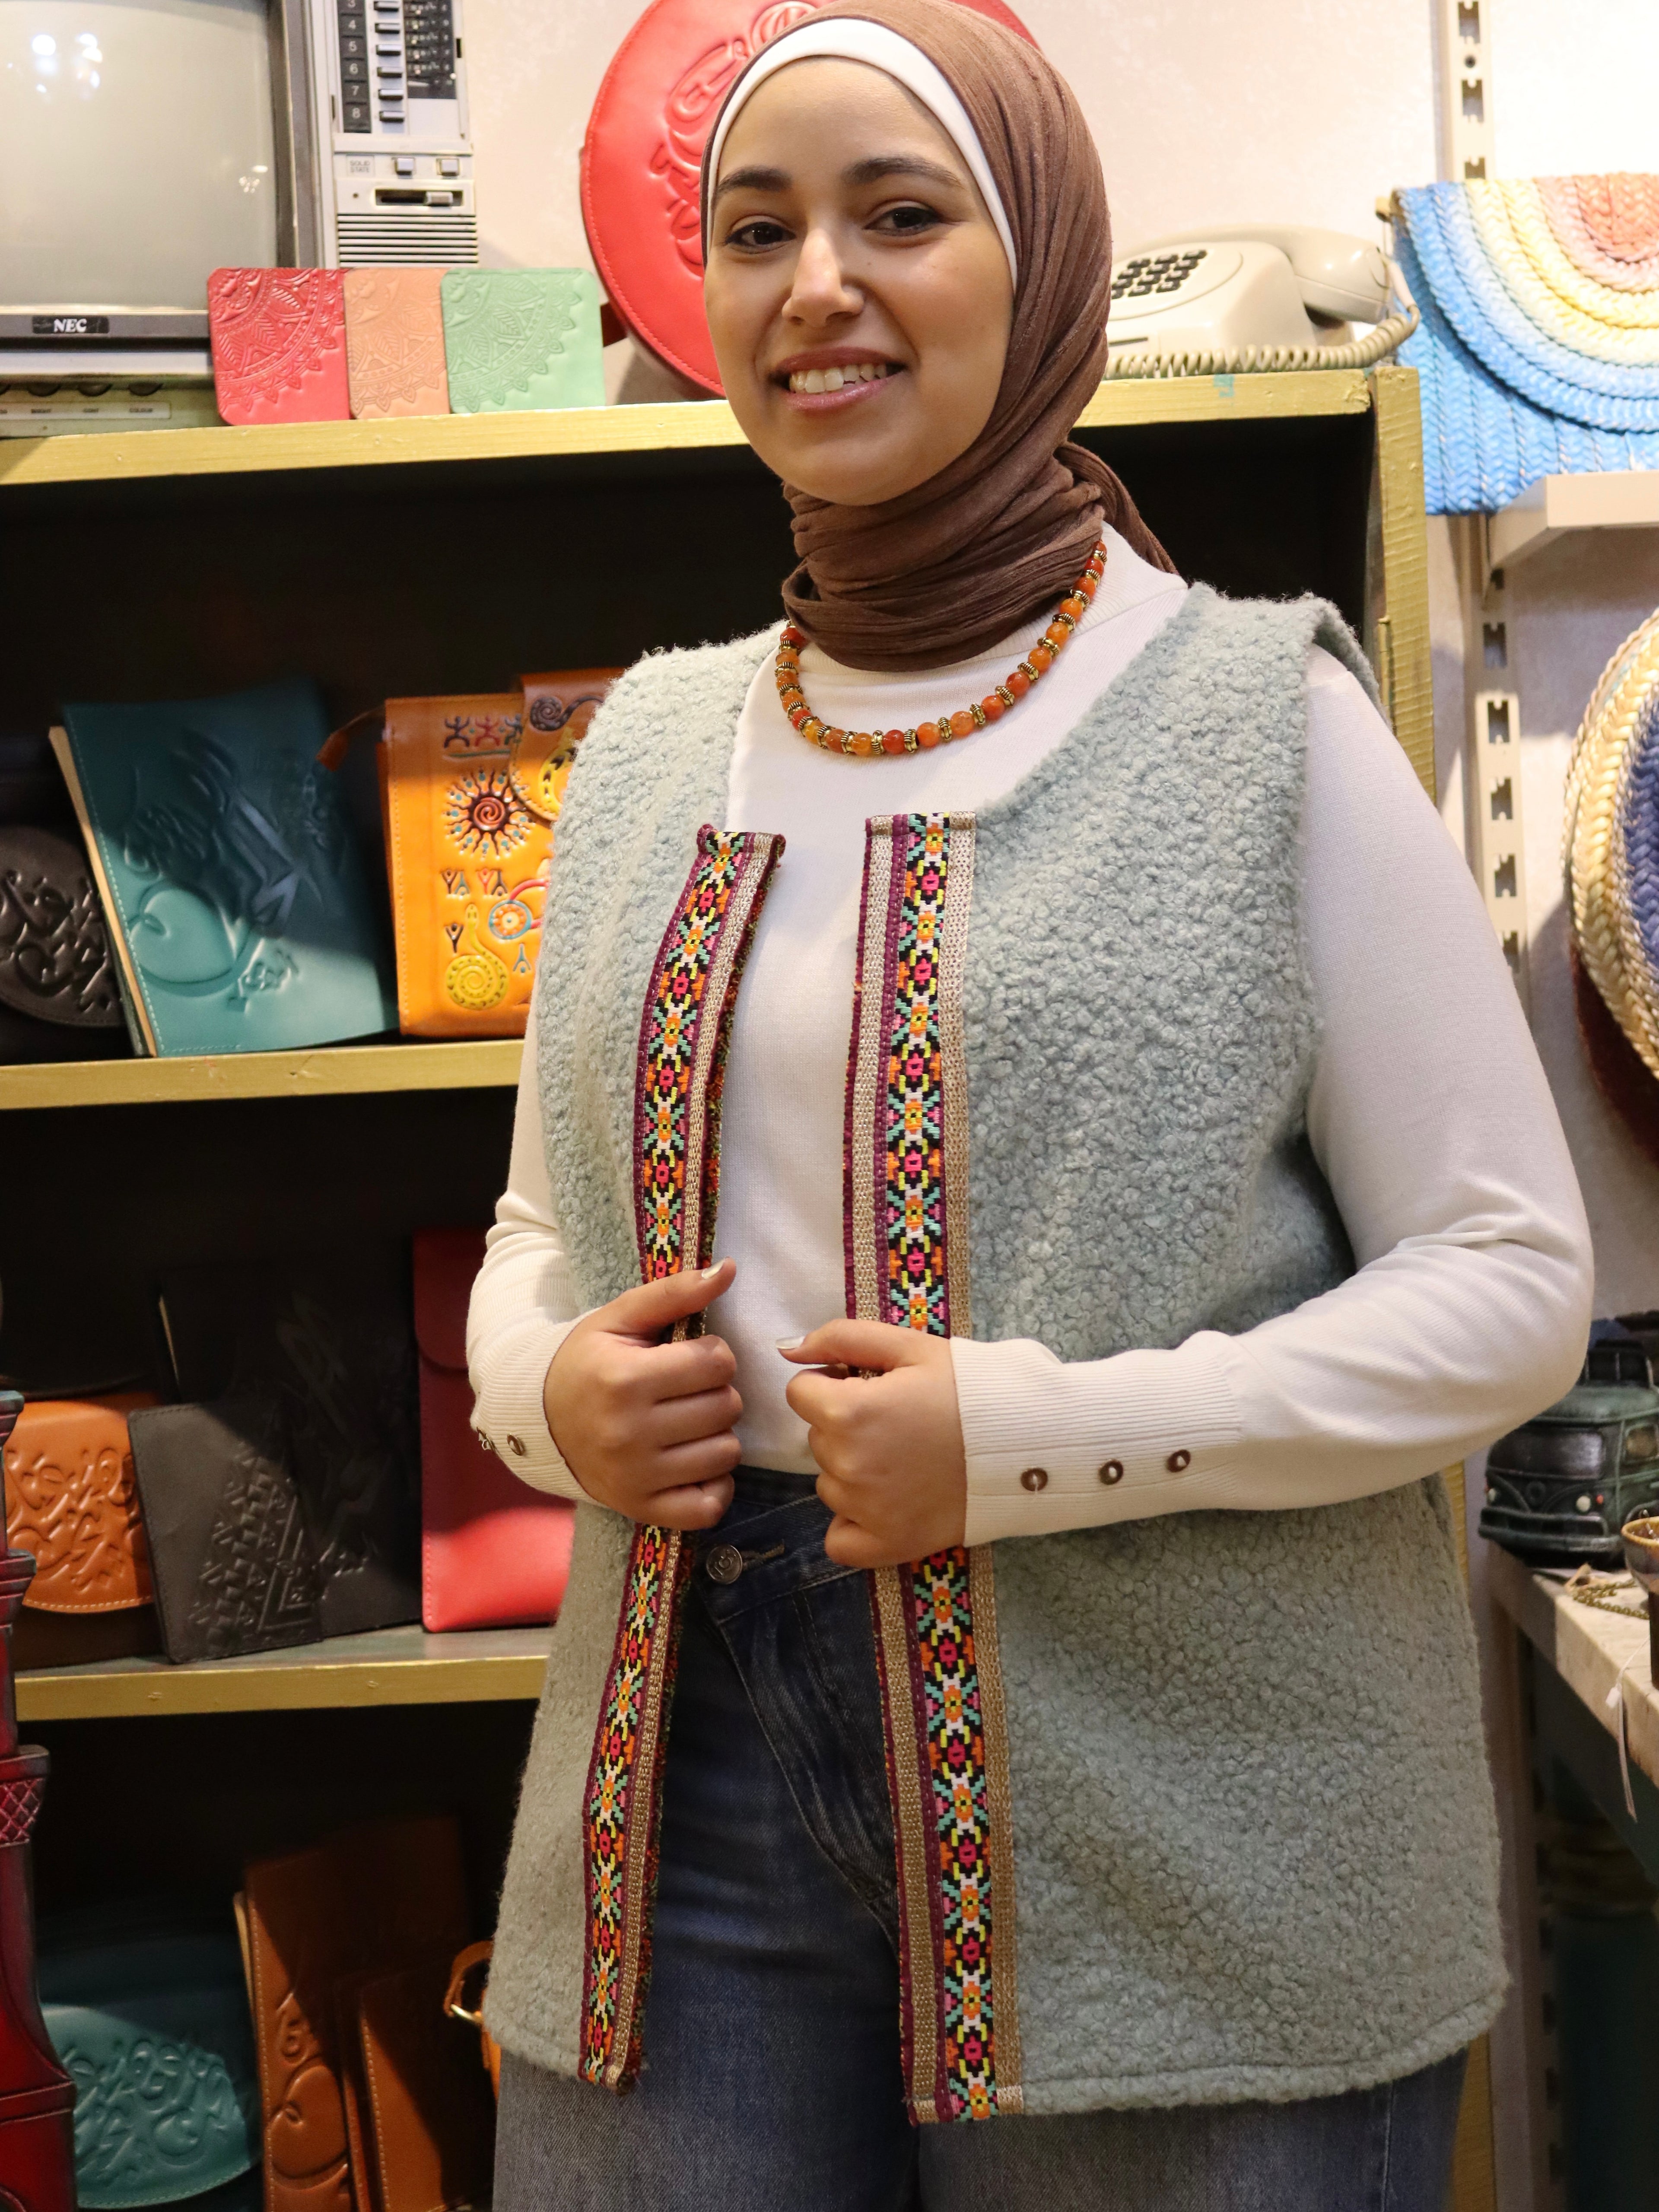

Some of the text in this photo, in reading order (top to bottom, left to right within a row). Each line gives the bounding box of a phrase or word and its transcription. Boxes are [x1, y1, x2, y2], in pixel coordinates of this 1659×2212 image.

[348, 20, 356, 29] 4
[350, 64, 358, 75] 6
[352, 86, 359, 95] 7
[352, 108, 361, 119] 8
[54, 318, 87, 333] NEC
